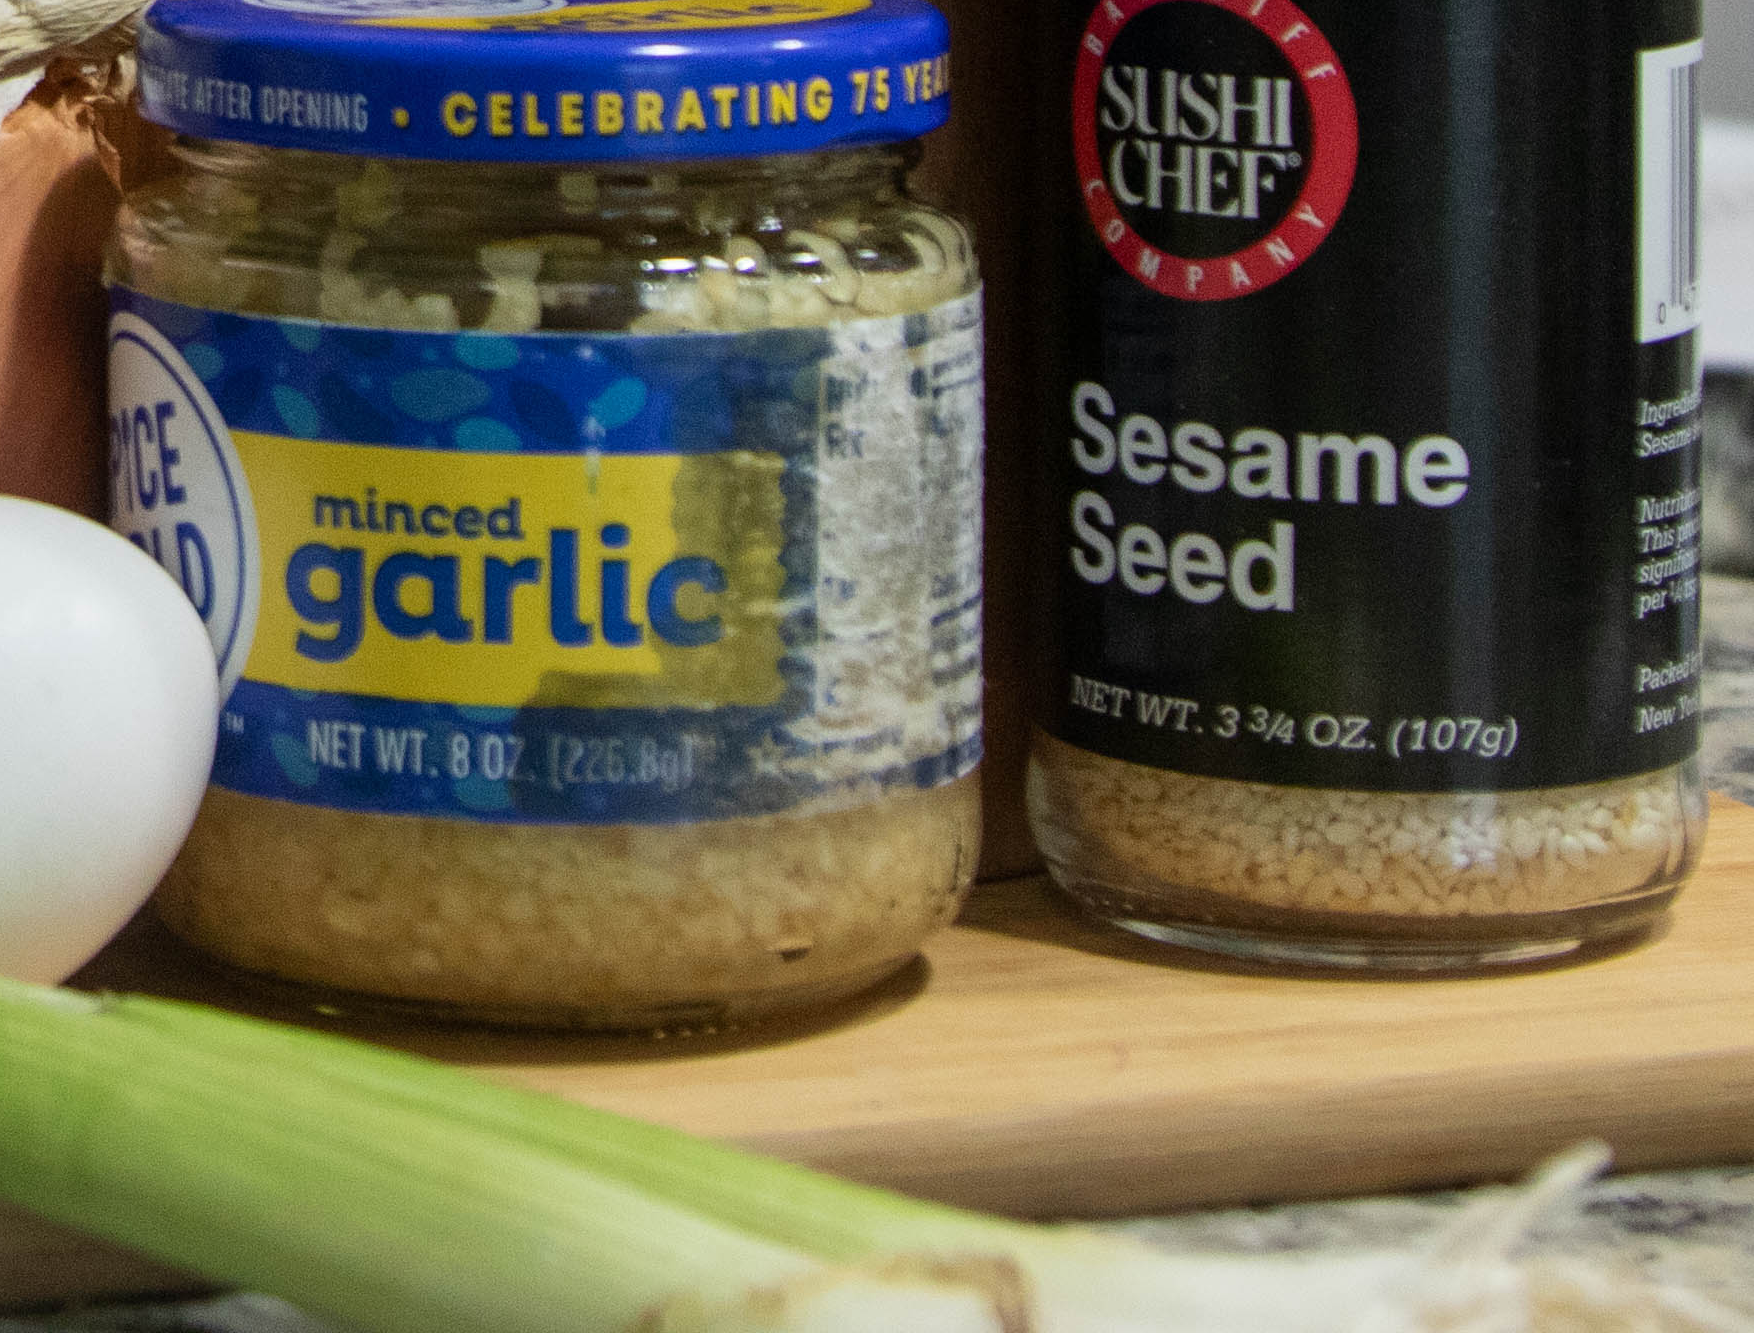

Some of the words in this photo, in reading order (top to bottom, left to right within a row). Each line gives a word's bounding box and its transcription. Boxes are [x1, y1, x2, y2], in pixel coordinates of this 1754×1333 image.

[194, 76, 252, 122] AFTER
[259, 85, 369, 134] OPENING
[441, 74, 833, 137] CELEBRATING
[849, 66, 890, 115] 75
[1100, 62, 1294, 150] SUSHI
[1085, 177, 1326, 292] COMPANY
[1069, 379, 1472, 508] Sesame
[311, 487, 527, 541] minced
[1069, 489, 1295, 613] Seed
[284, 523, 729, 663] garlic
[1639, 589, 1669, 620] per
[306, 719, 363, 770] NET
[374, 726, 439, 778] WT.
[449, 731, 471, 781] 8
[1070, 674, 1133, 719] NET
[1136, 691, 1203, 734] WT.
[1216, 705, 1241, 739] 3
[1307, 712, 1376, 751] OZ.
[1389, 713, 1519, 758] (107g)
[1638, 706, 1676, 734] New
